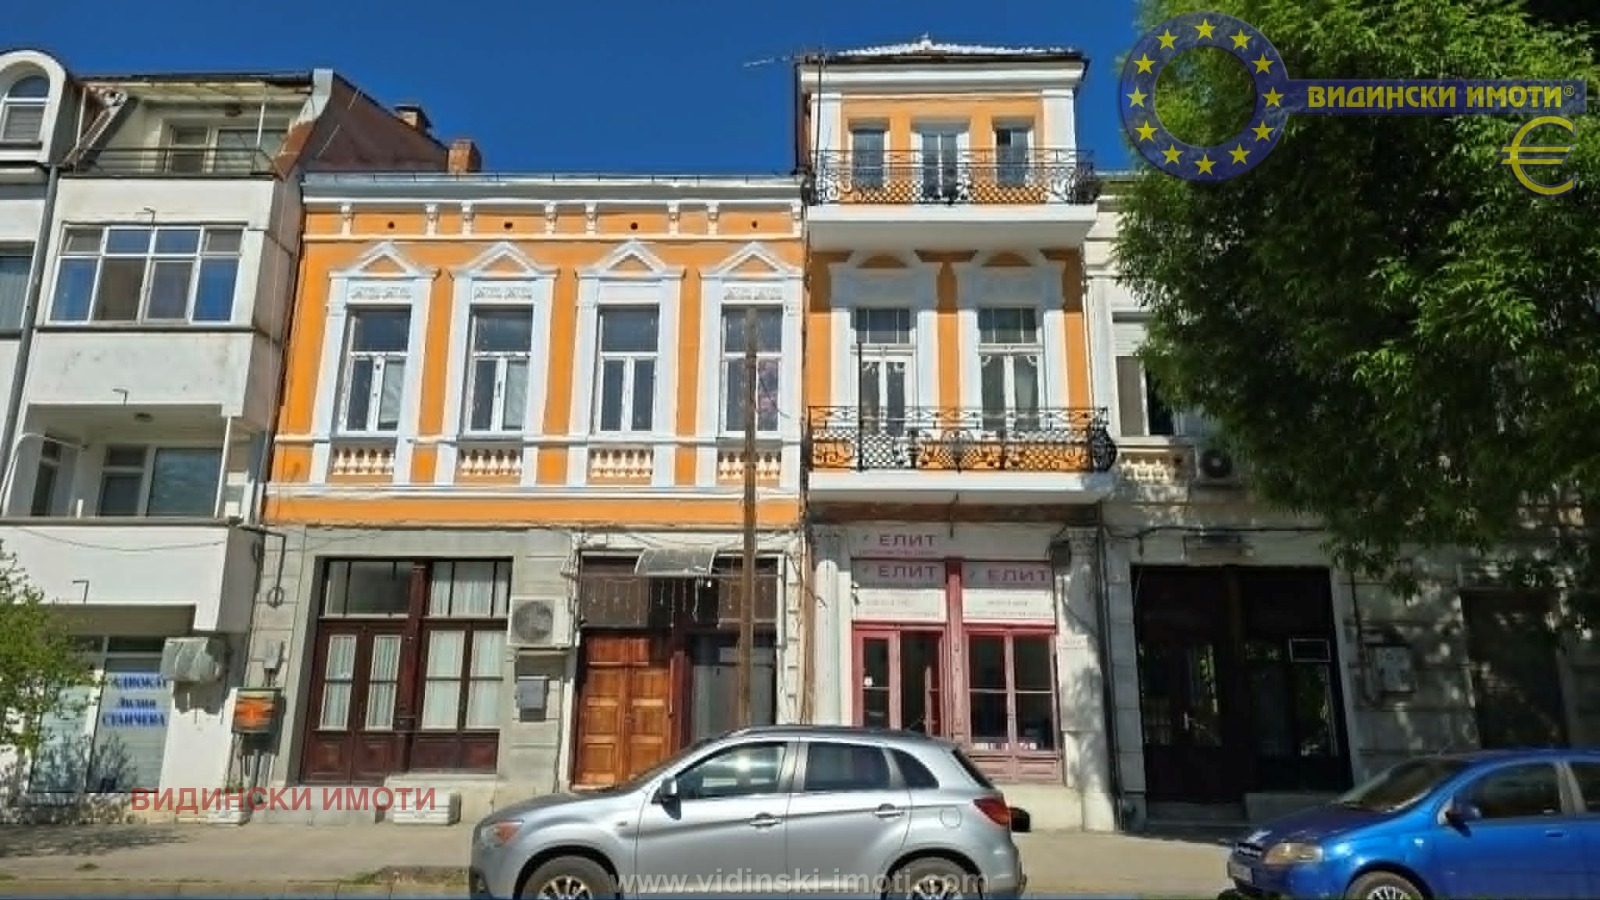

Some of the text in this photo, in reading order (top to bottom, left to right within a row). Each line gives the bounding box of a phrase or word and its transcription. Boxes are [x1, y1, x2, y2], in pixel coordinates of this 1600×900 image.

[879, 534, 936, 547] ЕЛИТ
[878, 566, 937, 579] ЕЛИТ
[987, 569, 1047, 582] ЕЛИТ
